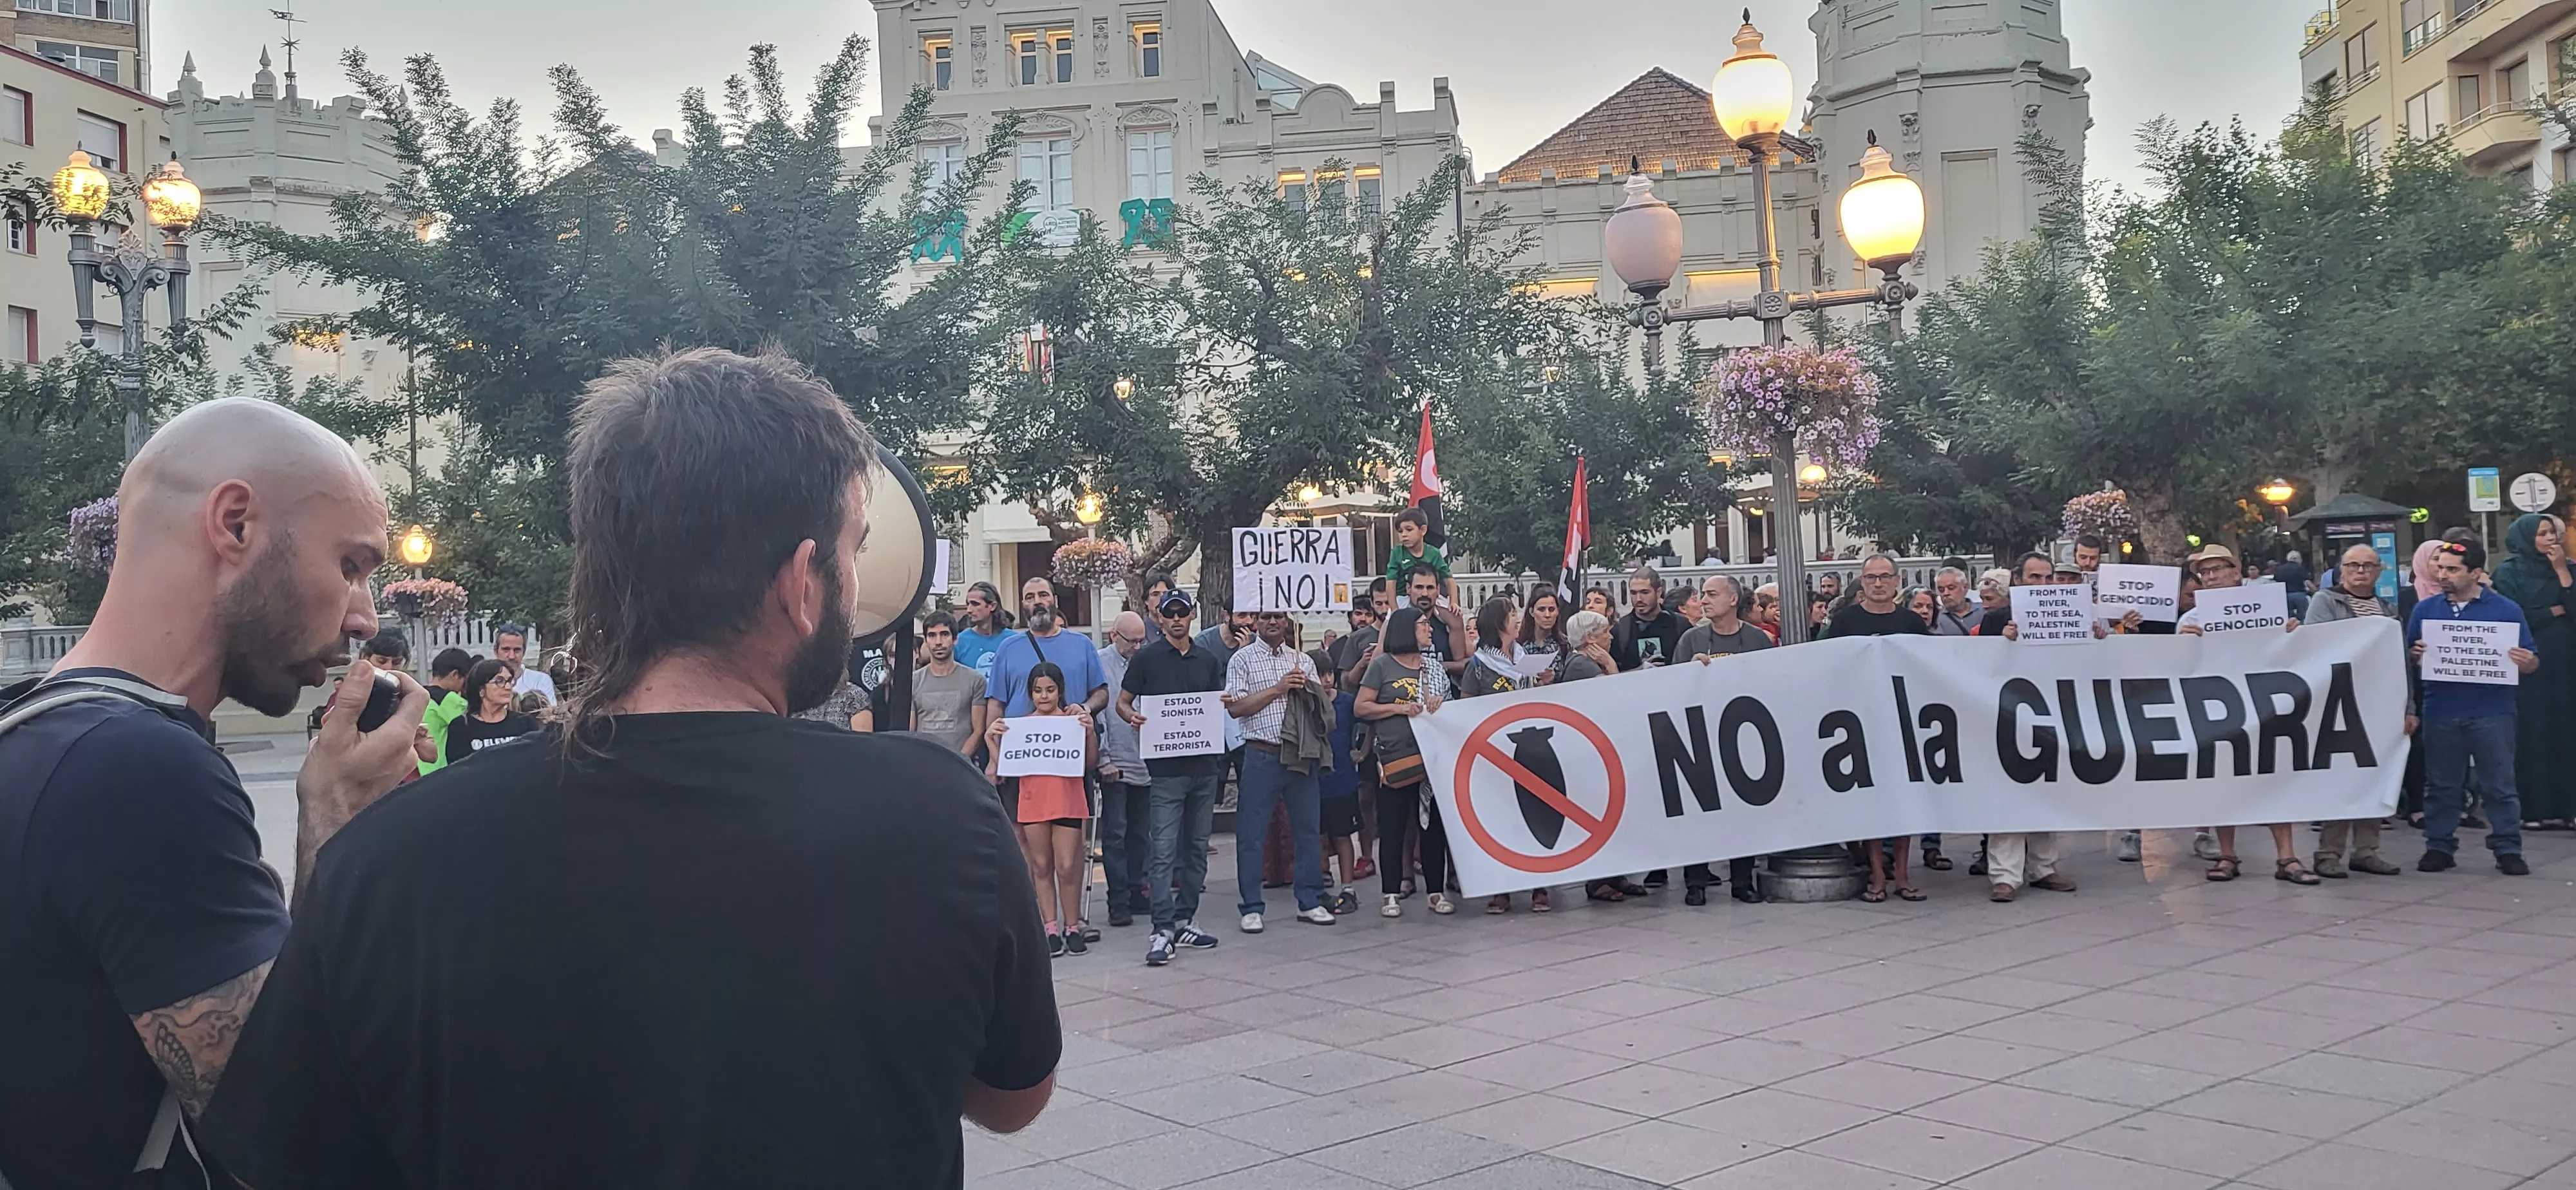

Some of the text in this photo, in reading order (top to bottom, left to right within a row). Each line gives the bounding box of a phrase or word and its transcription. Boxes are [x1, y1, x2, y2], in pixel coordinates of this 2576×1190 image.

[1240, 529, 1340, 567] GUERRA
[2118, 581, 2154, 591] STOP
[2100, 594, 2175, 606] GENOCIDIO
[2061, 610, 2083, 618] SEA,
[2224, 603, 2261, 615] STOP
[2204, 616, 2284, 632] GENOCIDIO
[2452, 636, 2486, 645] RIVER,
[2454, 647, 2474, 655] THE
[2477, 648, 2502, 657] SEA,
[2441, 657, 2499, 667] PALESTINE
[2433, 667, 2459, 675] WILL
[2479, 670, 2507, 679] FREE
[1164, 697, 1201, 706] ESTADO
[1161, 708, 1204, 717] SIONISTA
[1025, 733, 1062, 744] STOP
[1164, 730, 1201, 740] ESTADO
[1648, 663, 2378, 818] NO a la GUERRA
[1153, 741, 1211, 752] TERRORISTA
[1005, 748, 1081, 759] GENOCIDIO
